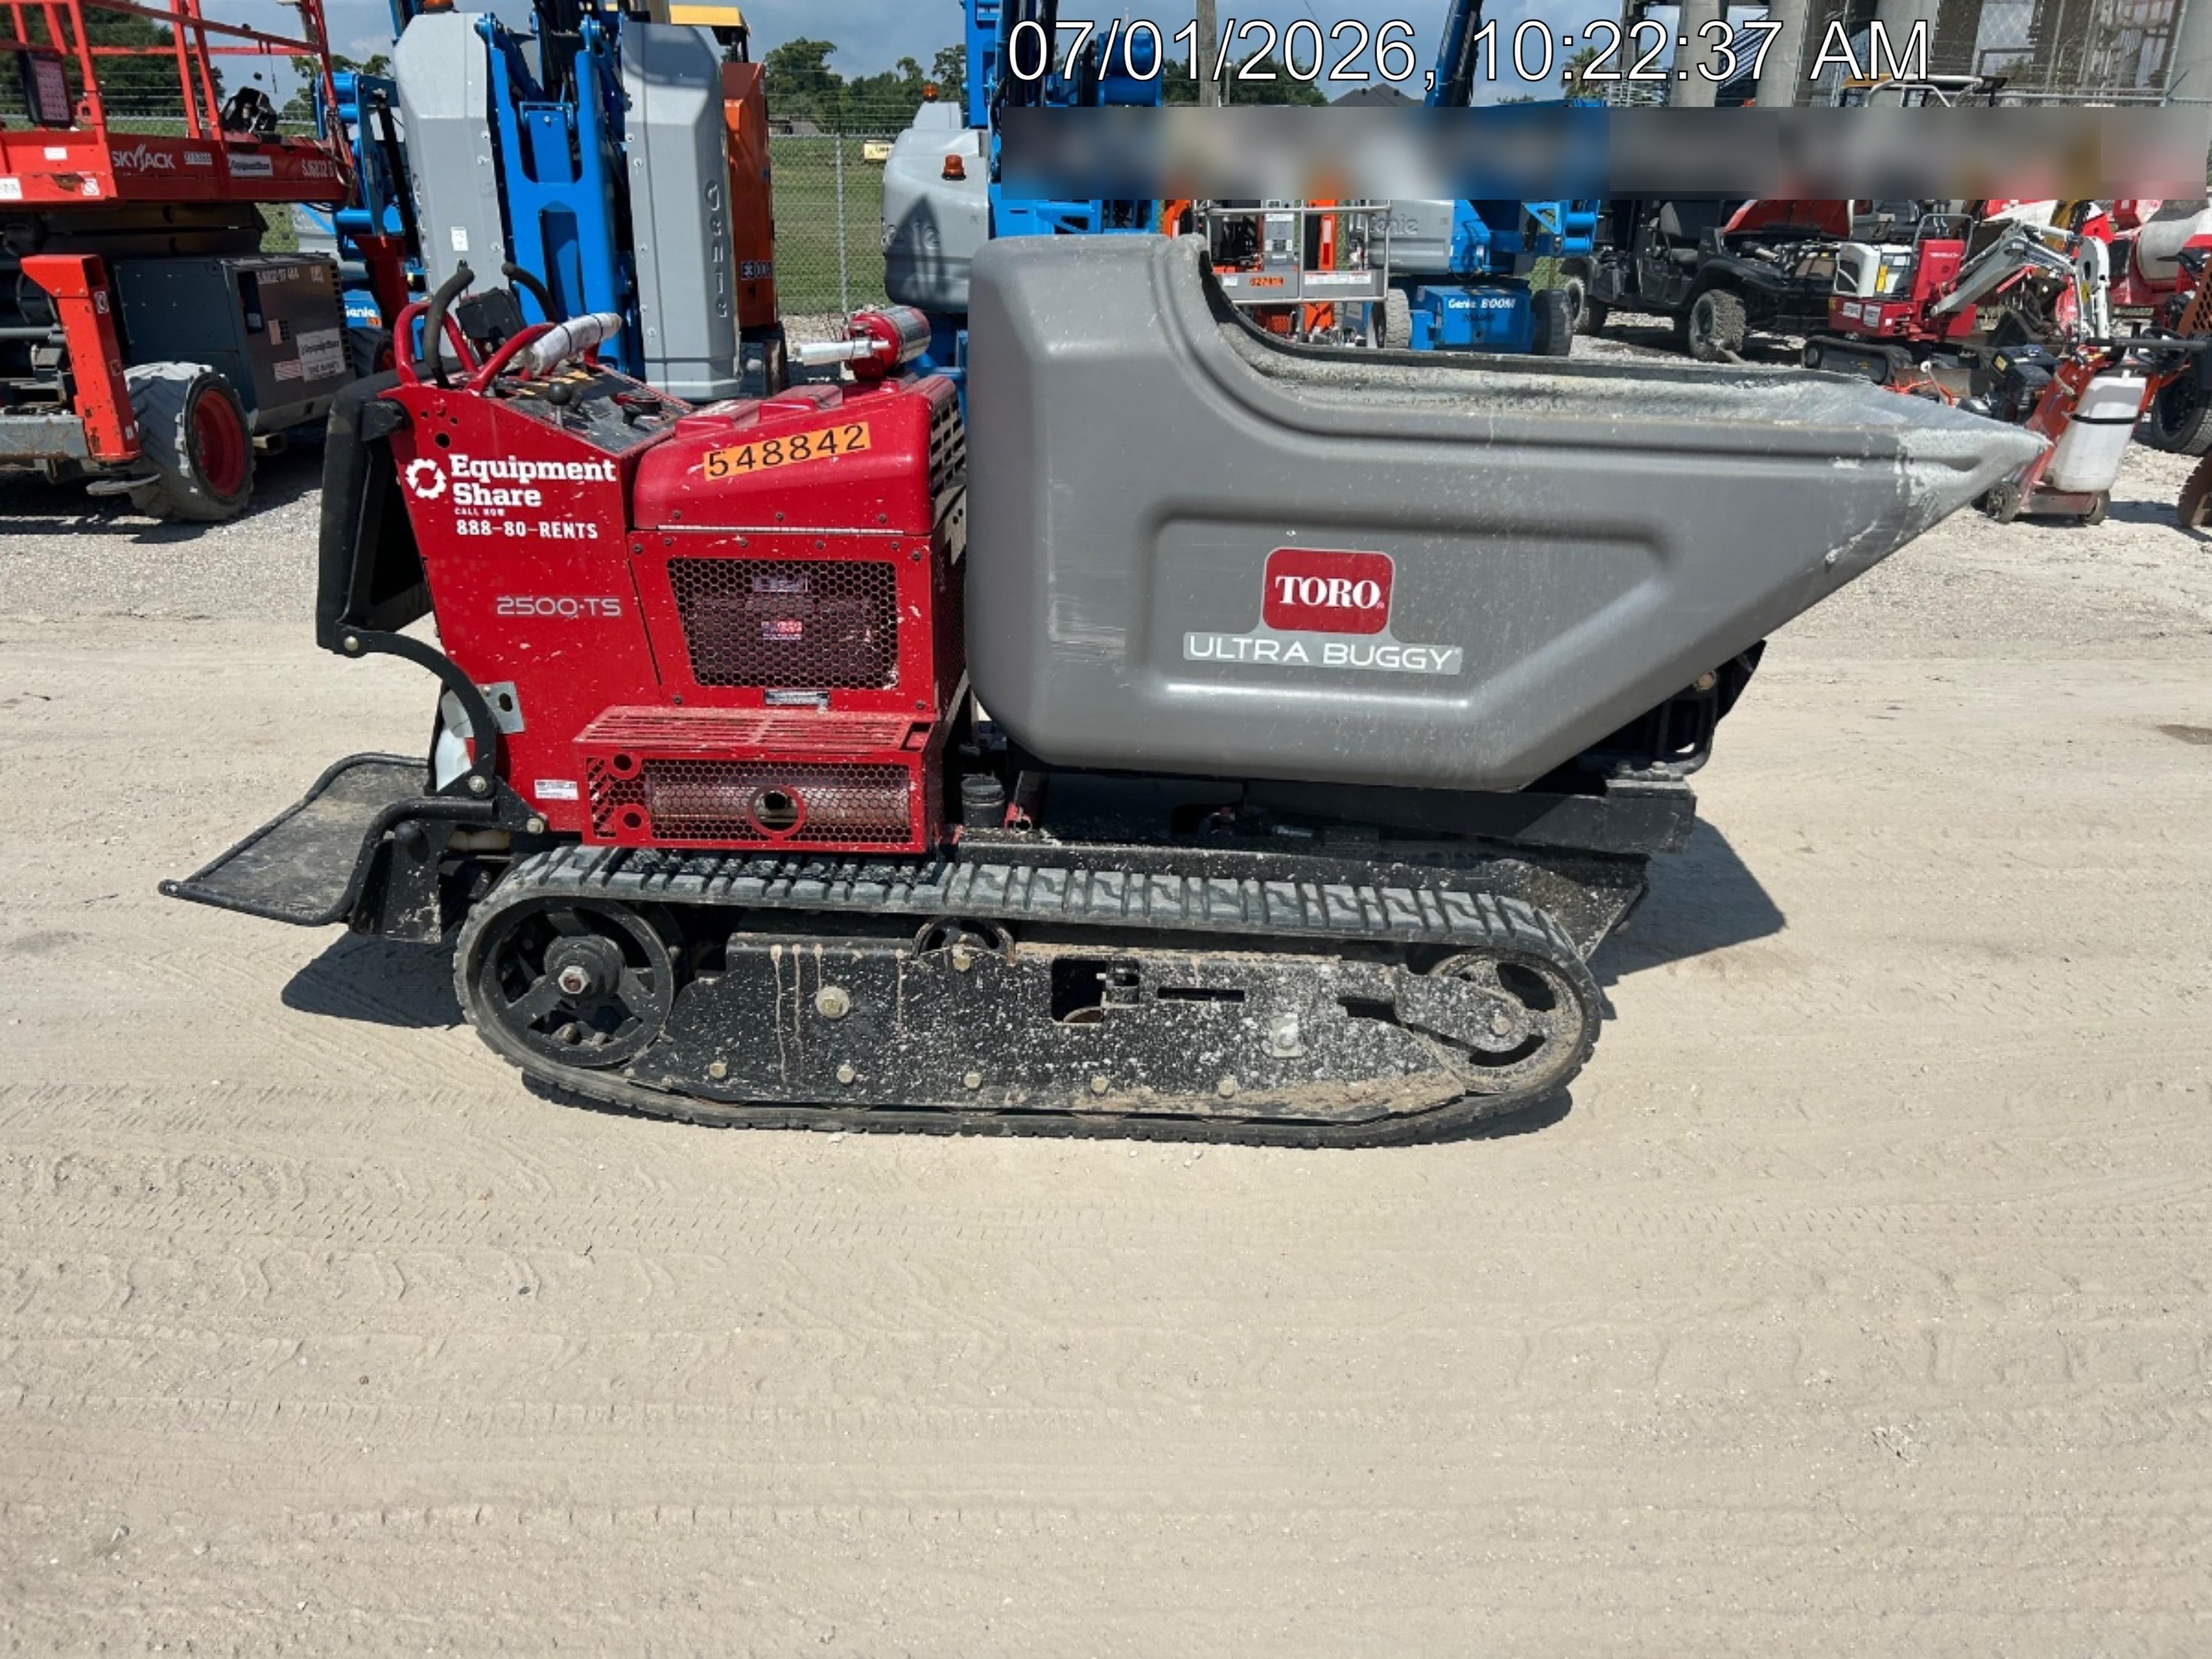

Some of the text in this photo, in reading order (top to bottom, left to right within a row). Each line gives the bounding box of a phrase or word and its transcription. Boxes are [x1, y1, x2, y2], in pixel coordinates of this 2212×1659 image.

[112, 143, 176, 173] SKYJACK
[709, 425, 865, 477] 548842
[448, 453, 618, 484] Equipment
[452, 482, 543, 507] Share
[455, 507, 505, 517] CALL NOW
[456, 519, 598, 539] 888-80-RENTS
[1275, 576, 1381, 609] TORO
[1190, 635, 1454, 670] ULTRA BUGGY
